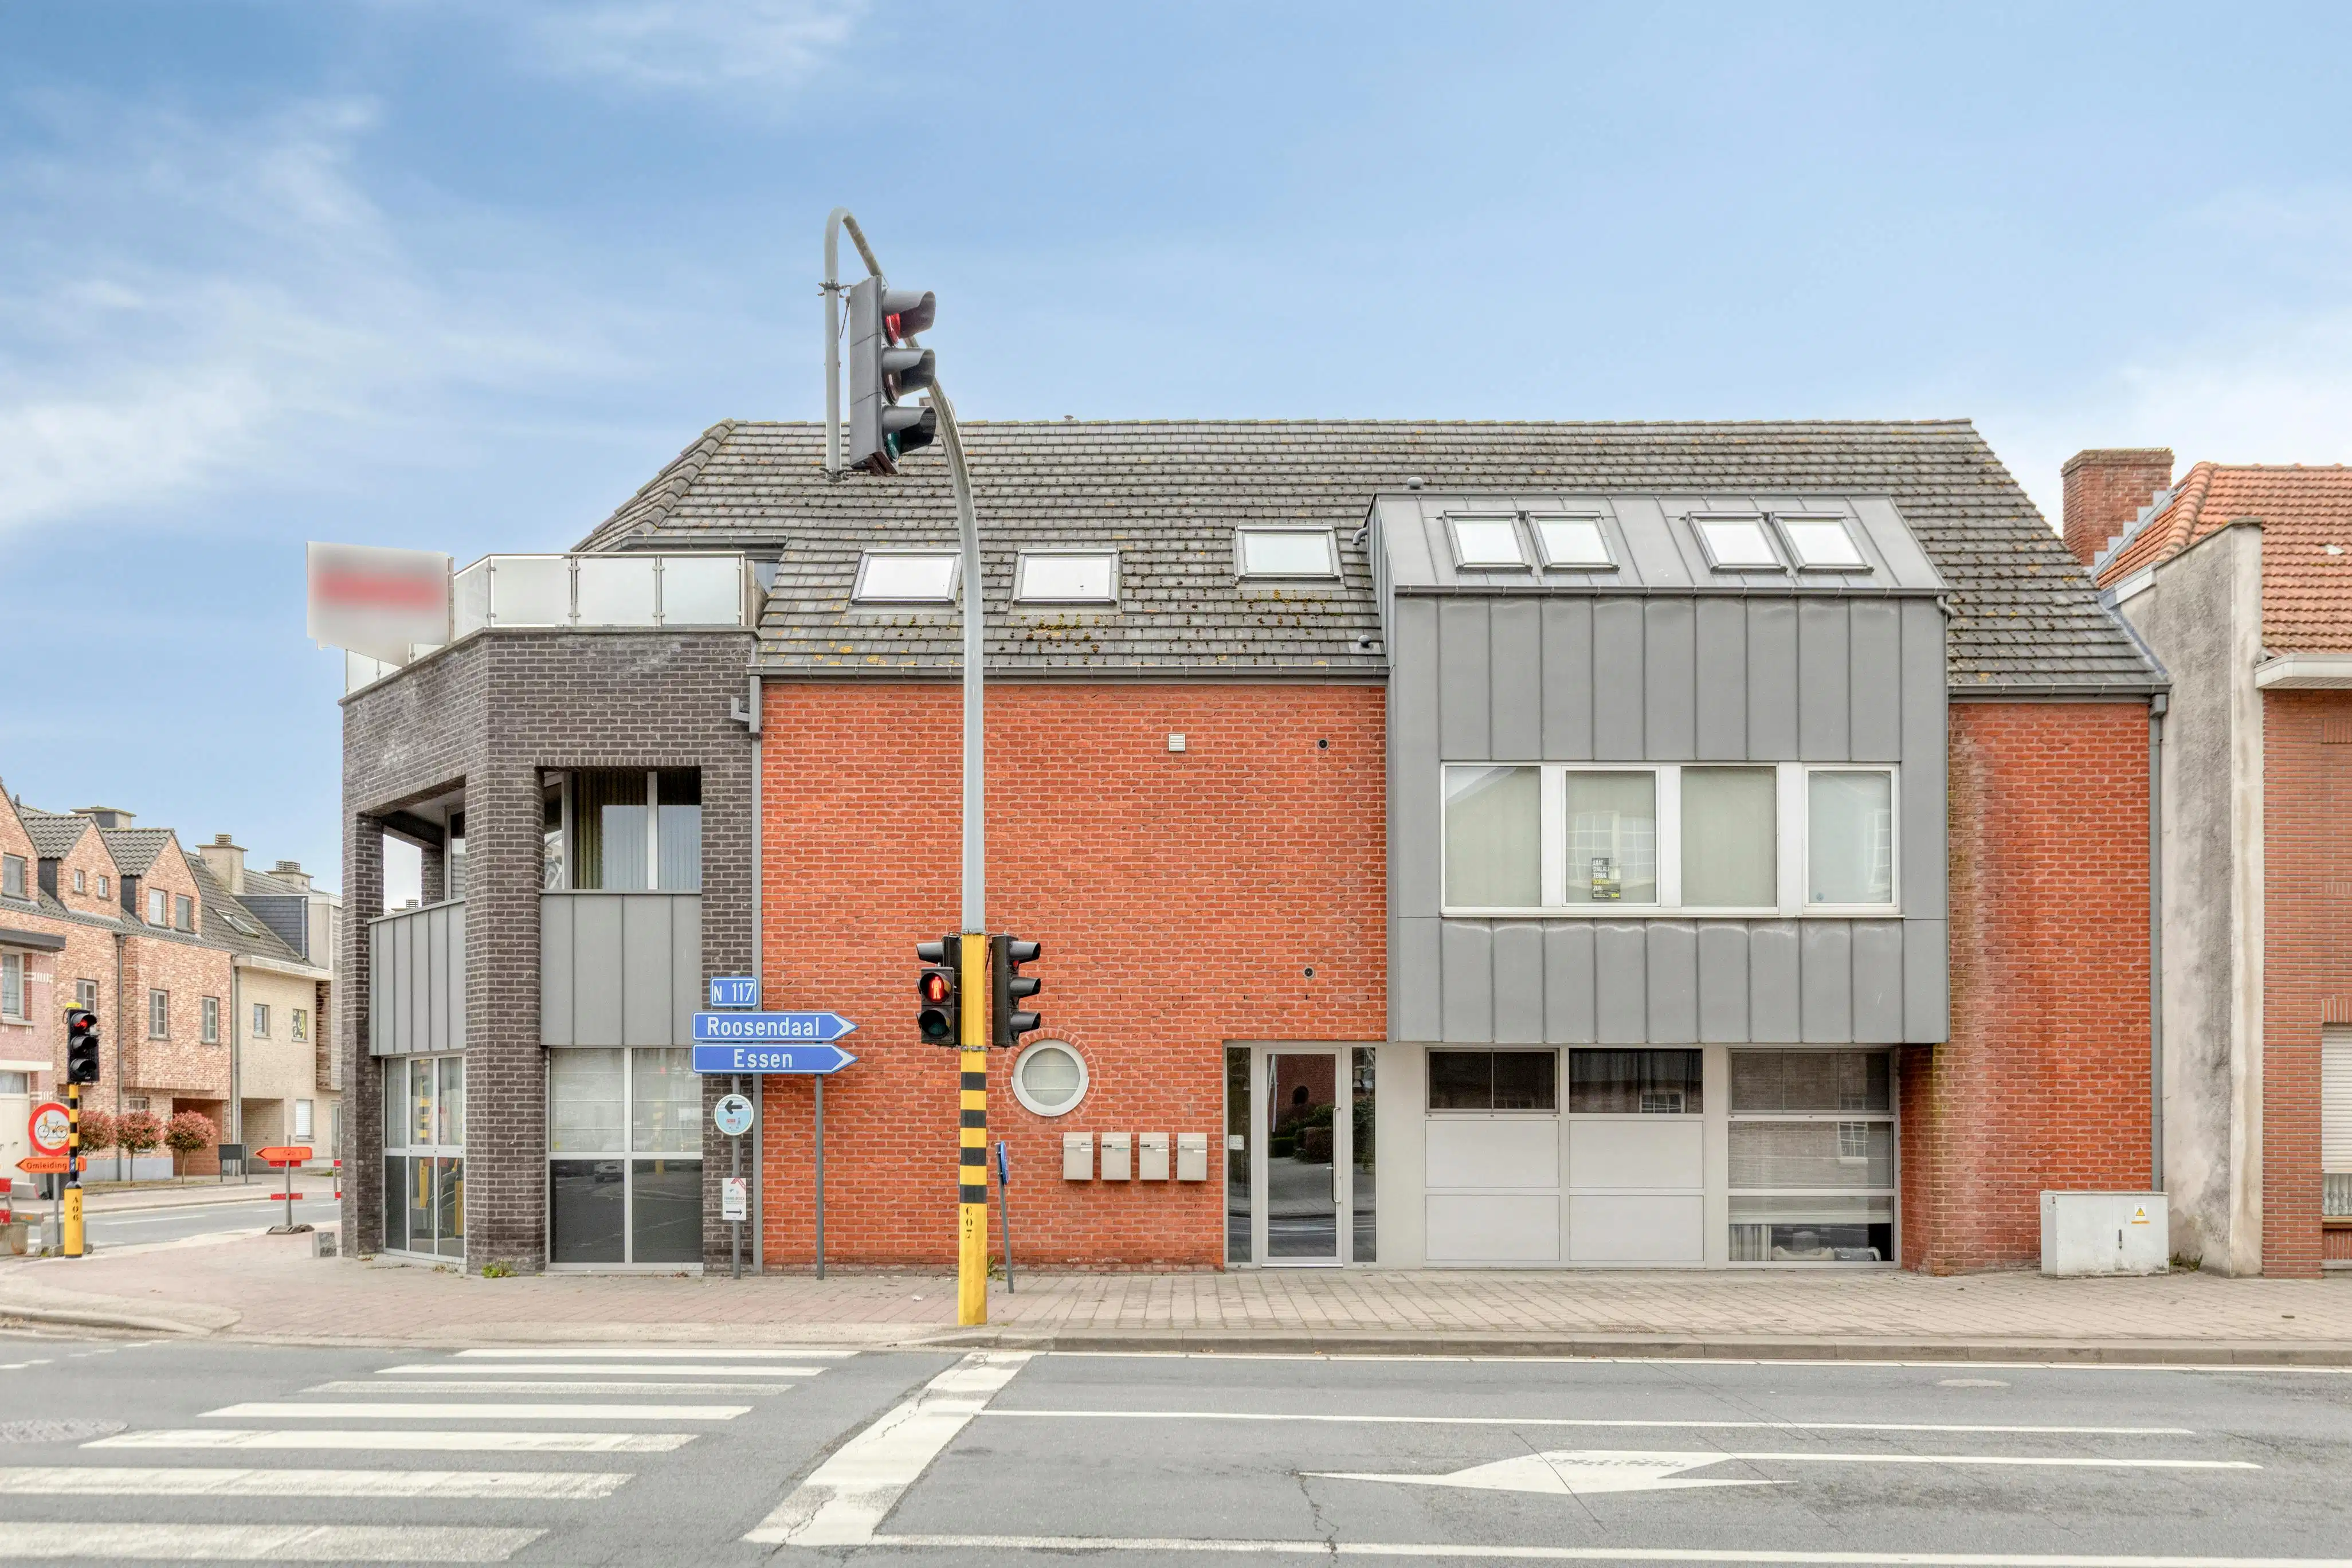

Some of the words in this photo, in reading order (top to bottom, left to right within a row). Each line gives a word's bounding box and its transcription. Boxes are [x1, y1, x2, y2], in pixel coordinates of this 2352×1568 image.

[714, 985, 722, 1001] N
[732, 983, 755, 1001] 117
[707, 1017, 820, 1036] Roosendaal
[734, 1048, 793, 1068] Essen
[26, 1162, 67, 1170] Omleiding
